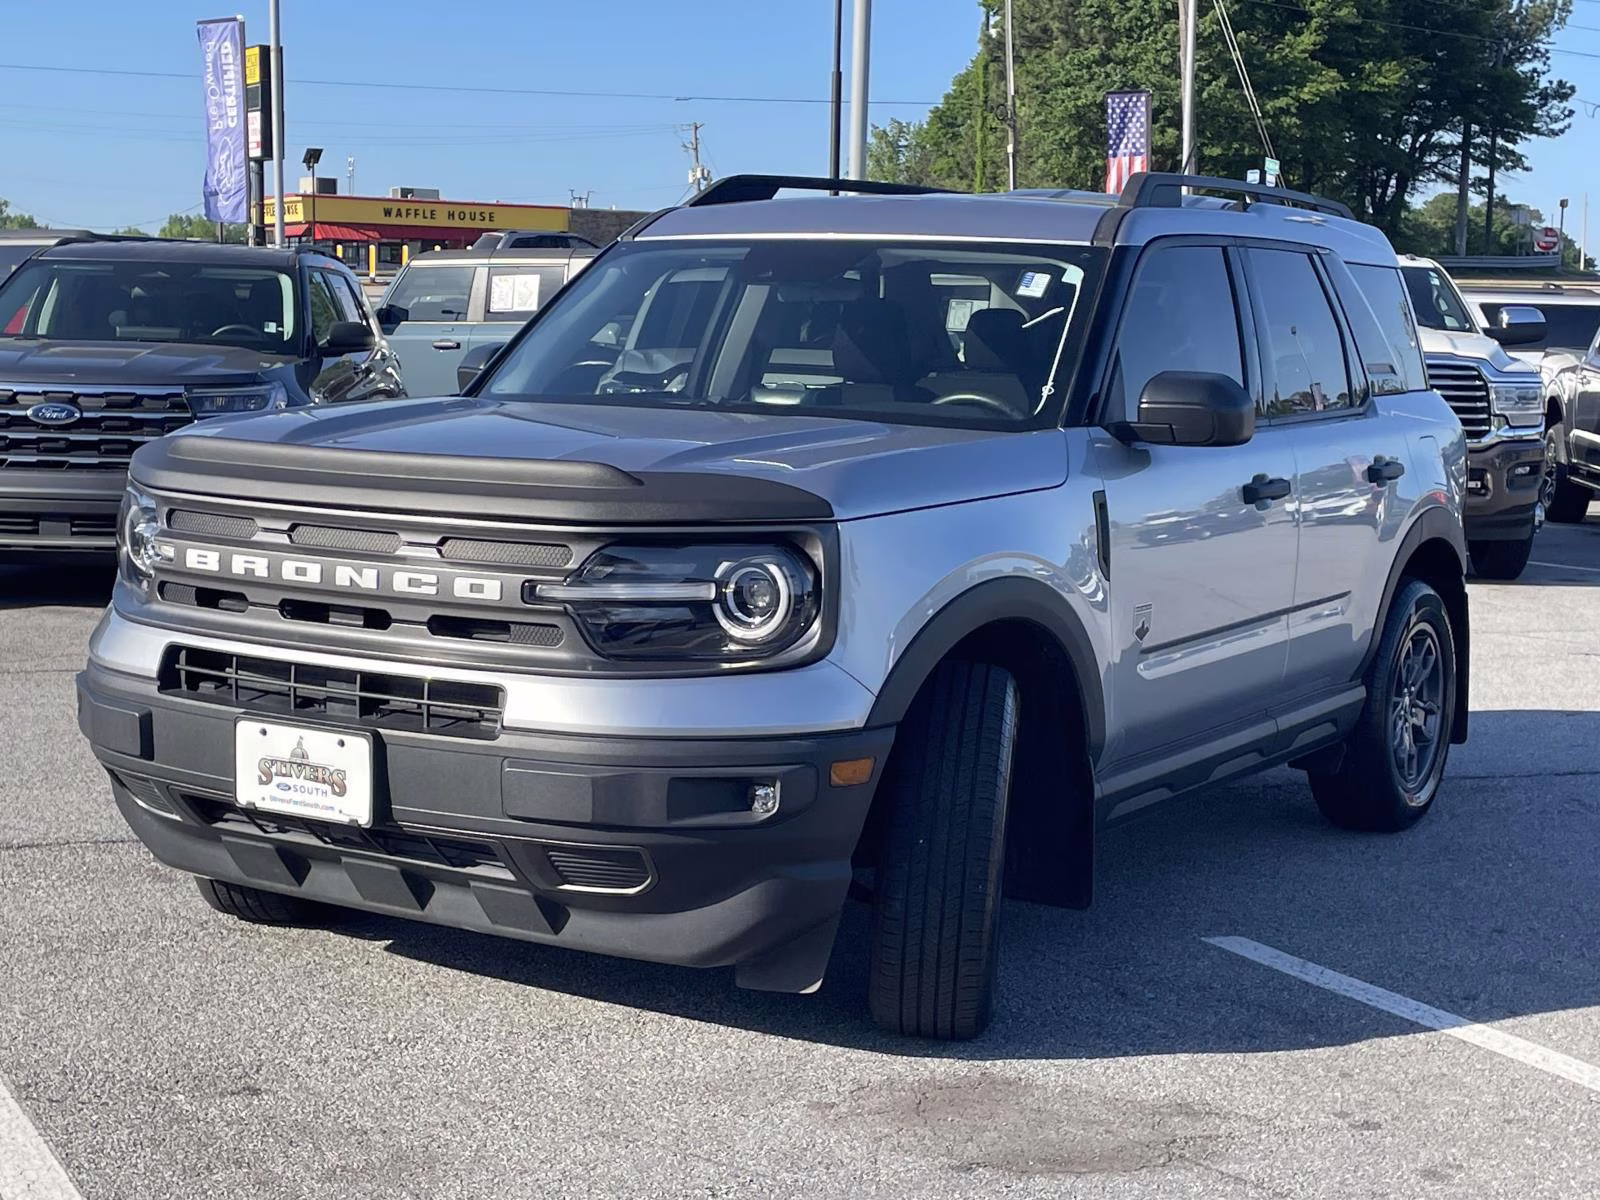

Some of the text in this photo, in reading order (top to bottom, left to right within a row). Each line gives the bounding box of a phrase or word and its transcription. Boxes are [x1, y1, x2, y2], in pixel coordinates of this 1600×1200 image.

[264, 203, 298, 217] FLE USE
[383, 207, 495, 222] WAFFLE HOUSE
[39, 406, 68, 419] Ford
[185, 548, 502, 600] BRONCO
[257, 757, 347, 797] STIVERS
[292, 785, 328, 798] SOUTH
